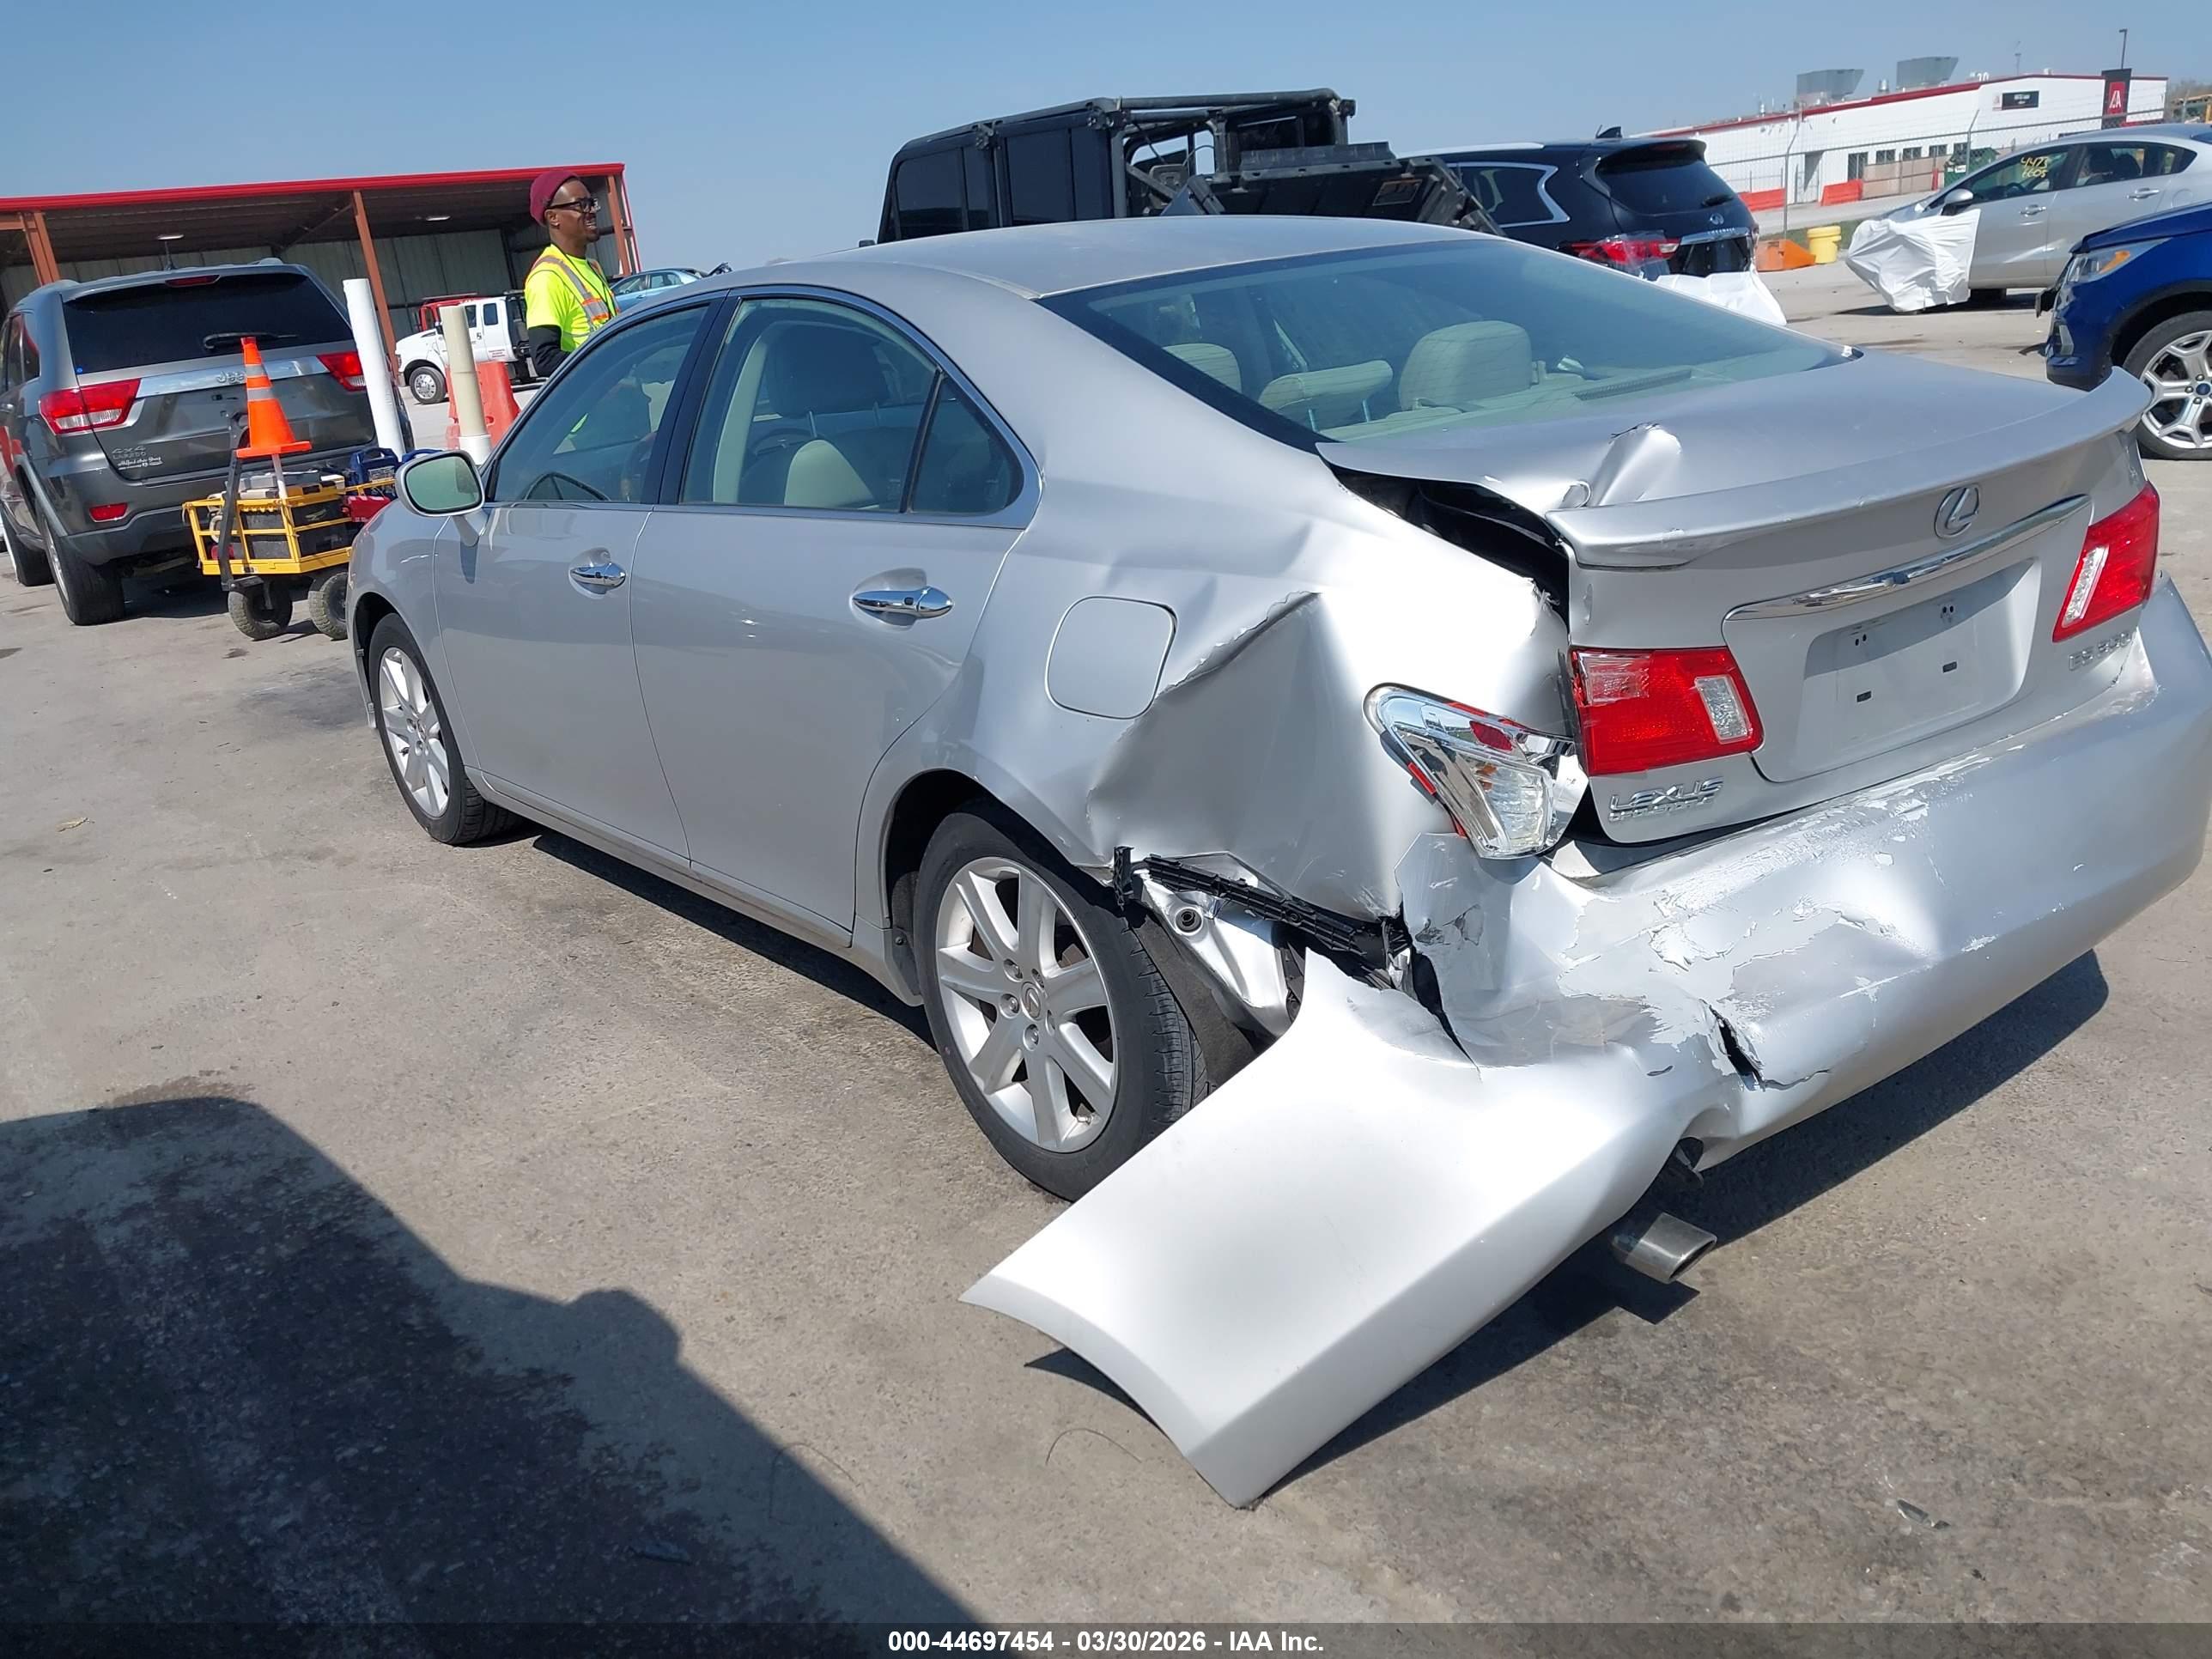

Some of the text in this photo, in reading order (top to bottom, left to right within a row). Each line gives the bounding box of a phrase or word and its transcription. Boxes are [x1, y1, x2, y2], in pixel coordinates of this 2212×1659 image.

[2021, 156, 2048, 169] 4473
[216, 370, 246, 384] Jee
[1610, 776, 1723, 811] LEXUS
